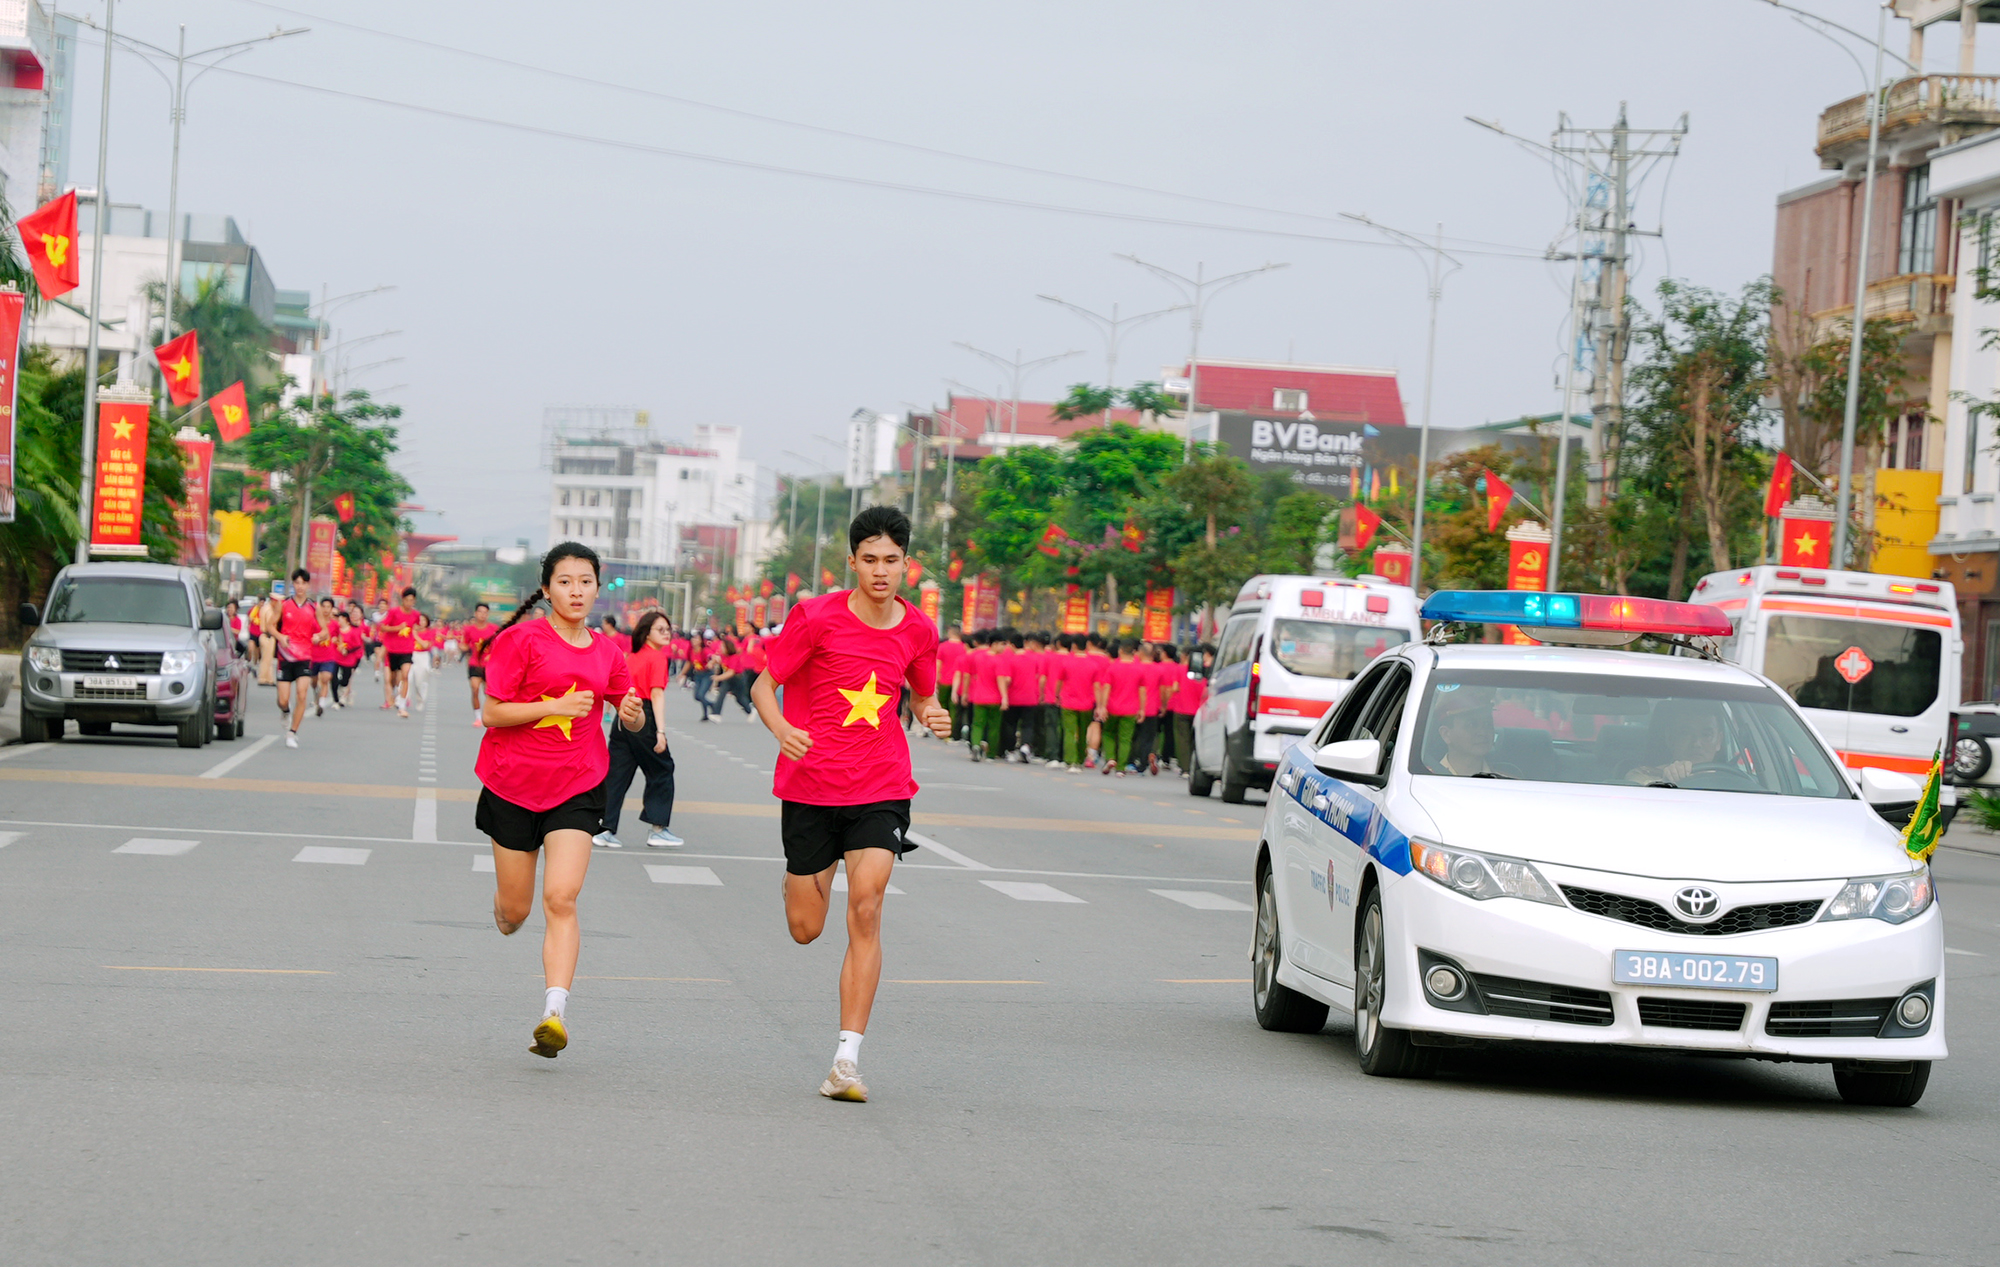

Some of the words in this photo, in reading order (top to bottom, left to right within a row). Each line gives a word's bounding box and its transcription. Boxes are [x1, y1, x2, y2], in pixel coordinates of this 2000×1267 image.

[1251, 420, 1364, 453] BVBank
[1251, 448, 1282, 463] Ngân
[1283, 450, 1313, 467] hàng
[1301, 607, 1387, 626] AMBULANCE
[1324, 791, 1355, 833] THÔNG
[1310, 869, 1326, 894] TRAFFIC
[1335, 882, 1350, 907] POLICE
[1628, 956, 1764, 984] 38A-002.79
